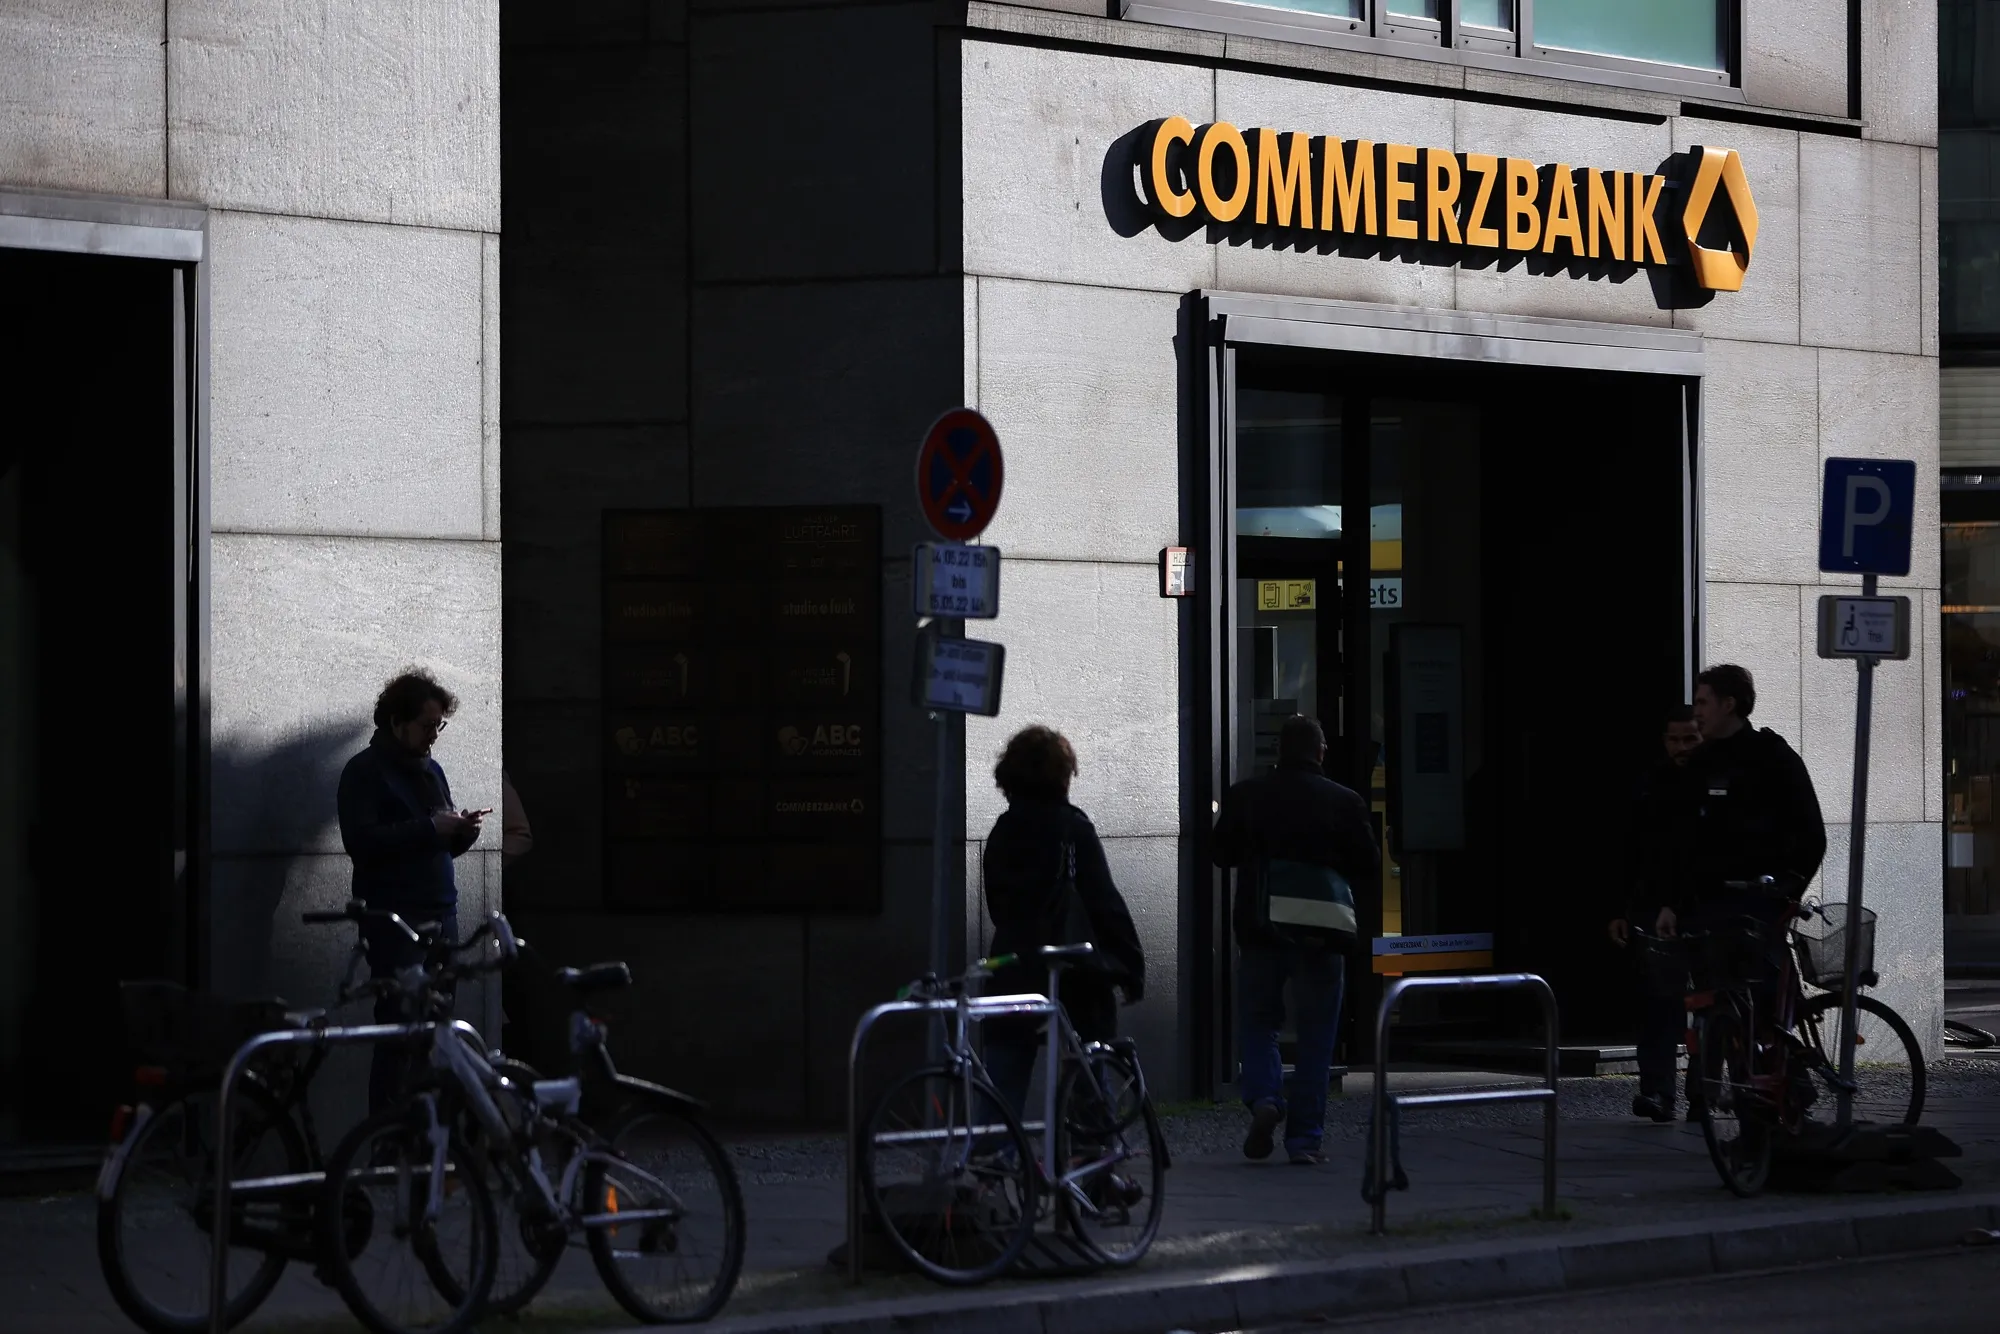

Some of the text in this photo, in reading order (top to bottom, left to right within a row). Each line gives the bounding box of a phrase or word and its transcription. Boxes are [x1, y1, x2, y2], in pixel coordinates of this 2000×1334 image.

[1151, 116, 1668, 266] COMMERZBANK
[1842, 474, 1892, 558] P
[650, 725, 698, 746] ABC
[812, 724, 861, 746] ABC
[776, 801, 849, 812] COMMERZBANK
